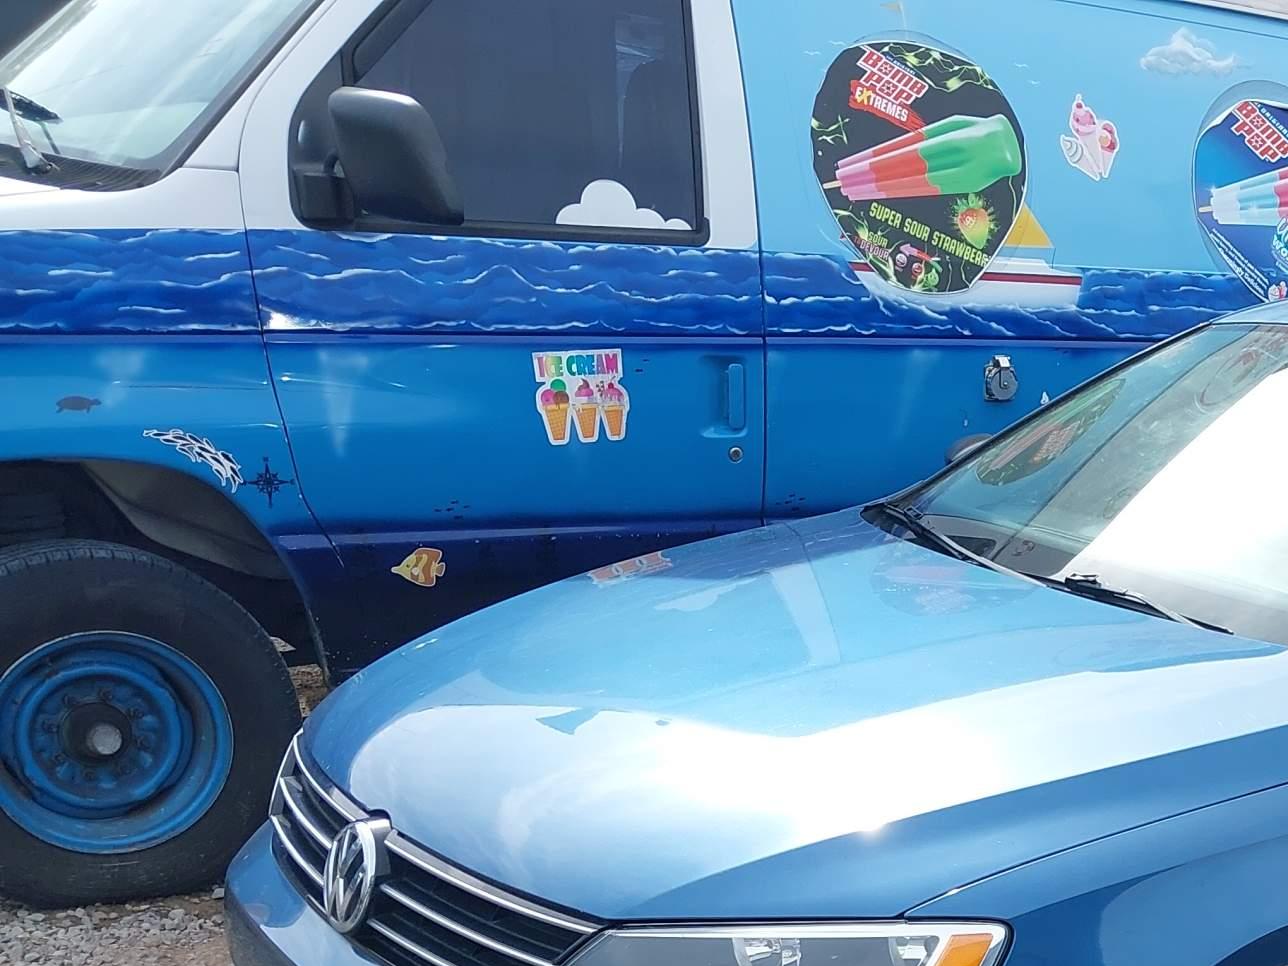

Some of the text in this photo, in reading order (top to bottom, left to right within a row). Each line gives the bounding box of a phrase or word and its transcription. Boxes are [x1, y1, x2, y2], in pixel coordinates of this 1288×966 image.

[855, 86, 908, 122] EXTREMES
[868, 231, 888, 249] SOUR
[869, 202, 991, 269] SUPER SOUR STRAWBERR
[860, 239, 890, 261] DEVOUR
[536, 353, 619, 378] ICE CREAM
